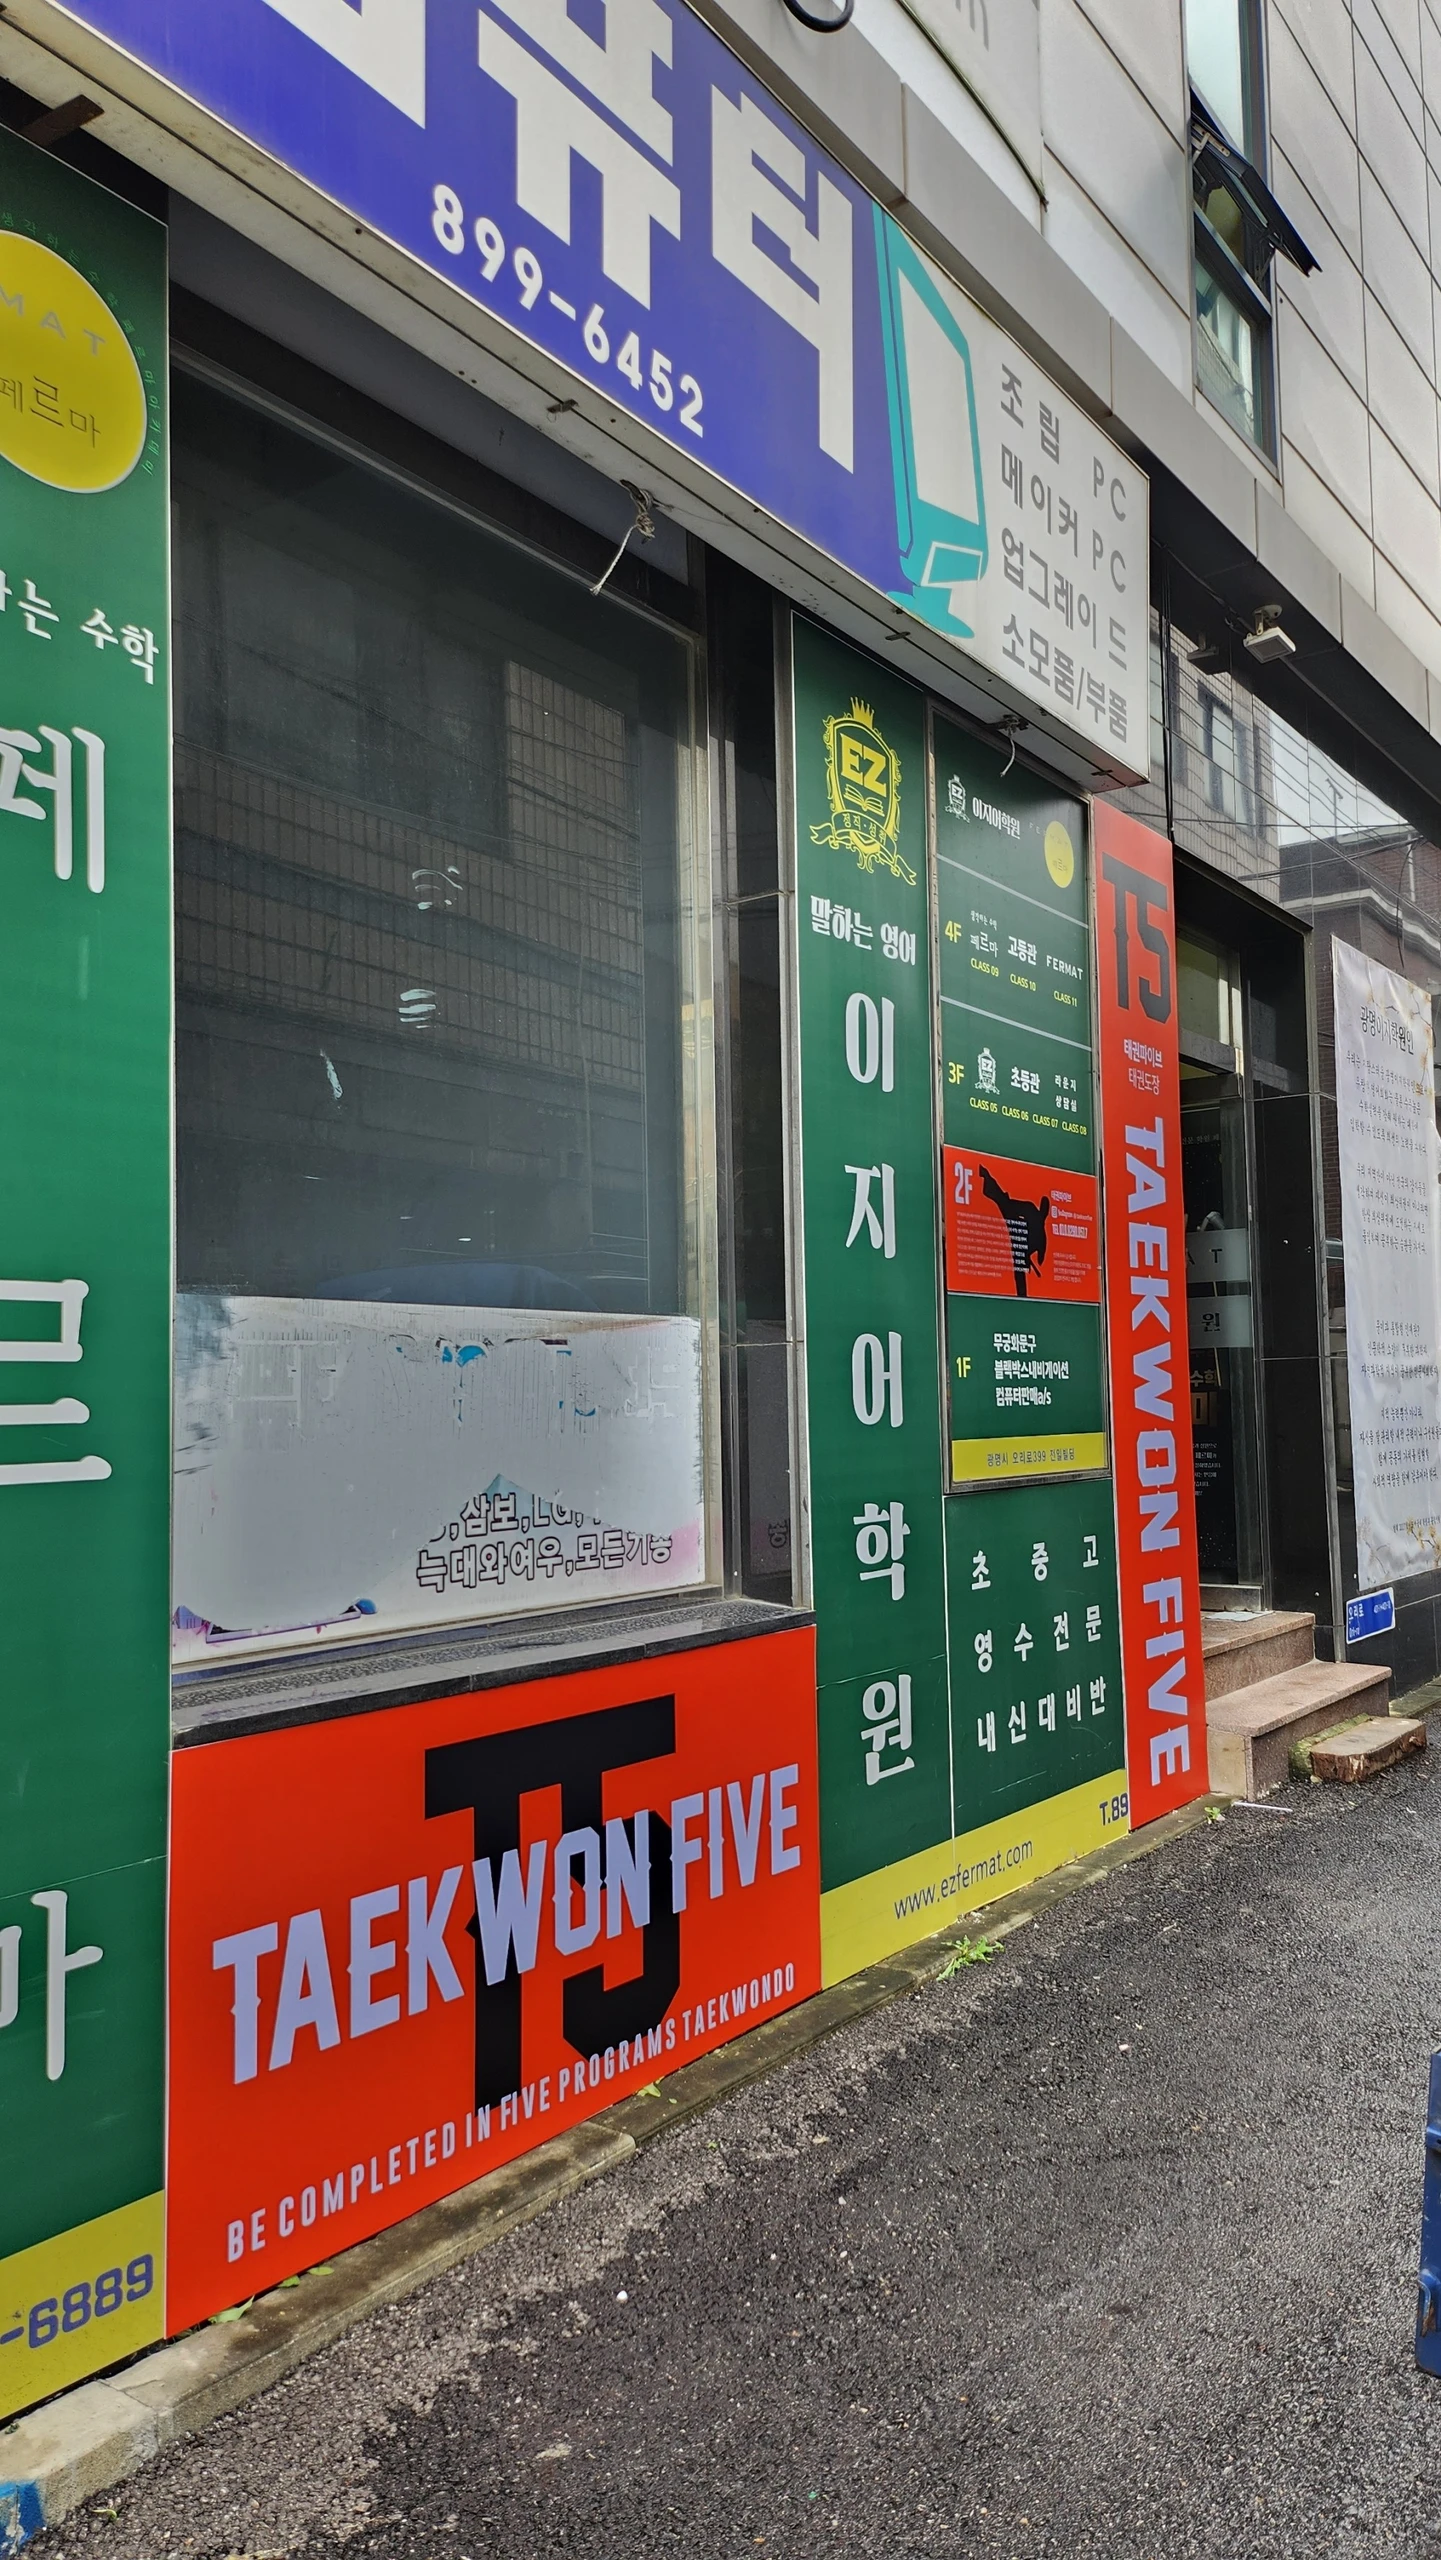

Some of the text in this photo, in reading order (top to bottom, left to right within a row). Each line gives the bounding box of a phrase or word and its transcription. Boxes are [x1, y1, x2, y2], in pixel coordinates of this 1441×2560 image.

[265, 0, 853, 474] 퓨터
[432, 184, 703, 438] 899-6452
[1093, 456, 1127, 523] PC
[1001, 442, 1127, 594] 메이커 PC
[1001, 527, 1127, 671] 업그레이드
[80, 607, 160, 686] 수학
[1002, 613, 1128, 743] 소모품/부품
[840, 732, 887, 798] EZ
[972, 797, 1021, 840] 이지어학원
[810, 894, 916, 967] 말하는 영어
[944, 920, 962, 943] 4F
[970, 931, 999, 958] 페르마
[970, 957, 999, 977] CLASS 09
[1008, 935, 1038, 966] 고등관
[1046, 954, 1084, 980] FERMAT
[1010, 973, 1036, 991] CLASS 10
[1053, 990, 1078, 1007] CLASS 11
[1123, 1038, 1163, 1068] 태권파이브
[948, 1061, 965, 1085] 3F
[1010, 1066, 1040, 1094] 초등관
[1128, 1067, 1160, 1096] 태권도장
[969, 1096, 989, 1112] CLASS
[990, 1102, 998, 1113] 05
[1001, 1105, 1020, 1119] CLASS
[1032, 1113, 1050, 1127] CLASS
[1051, 1118, 1058, 1128] 07
[1062, 1120, 1079, 1134] CLASS
[1055, 1094, 1077, 1113] 상담실
[954, 1161, 973, 1205] 2F
[993, 1332, 1037, 1354] 무궁화문구
[956, 1356, 971, 1378] 1F
[845, 991, 916, 1787] 이지어학원
[995, 1386, 1052, 1407] 컴퓨터판매a/s
[987, 1453, 1008, 1467] 광명시
[1012, 1451, 1046, 1464] 오리로399
[1124, 1116, 1192, 1788] TAEKWON FIVE
[893, 1838, 1034, 1920] www.ezfermat.com
[212, 1763, 801, 2085] TAEKWON FIVE
[227, 1961, 796, 2263] BE COMPLETED IN FIVE PROGRAMS TAEKWONDO
